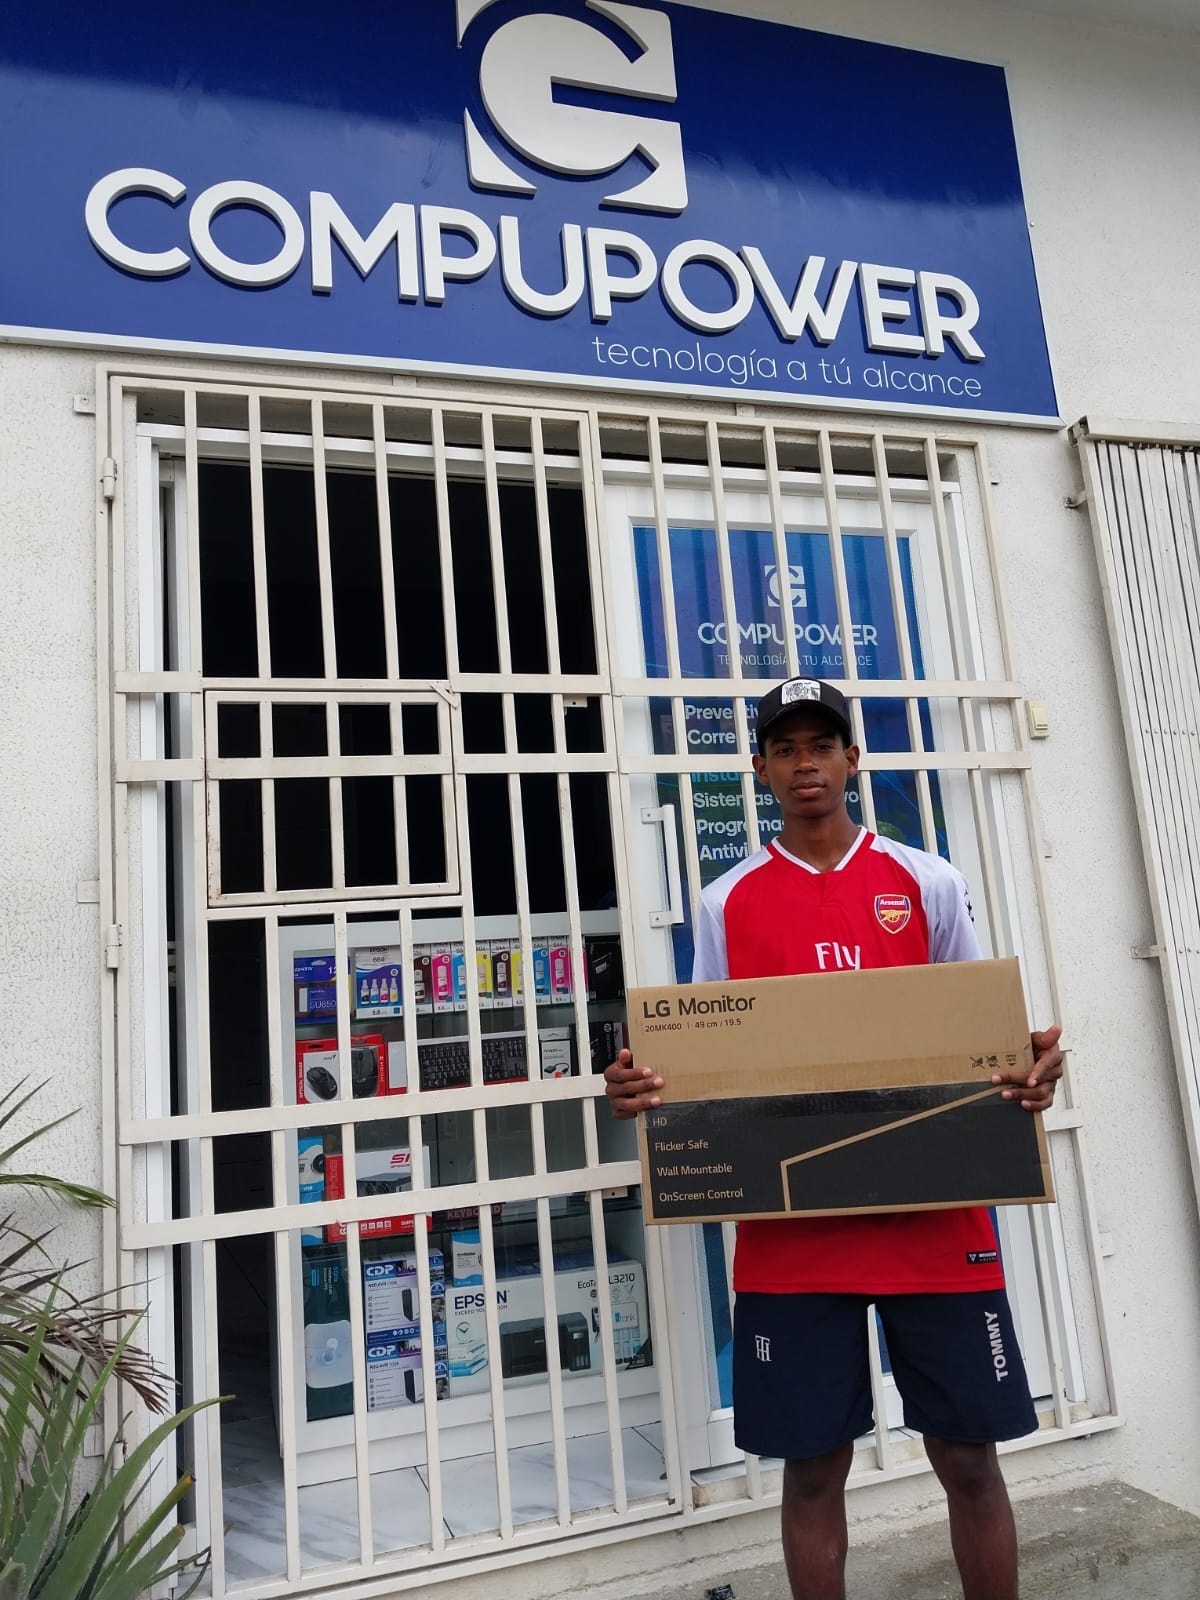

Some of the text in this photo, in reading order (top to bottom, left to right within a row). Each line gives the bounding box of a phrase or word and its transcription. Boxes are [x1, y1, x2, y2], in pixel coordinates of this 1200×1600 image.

[84, 166, 986, 363] COMPUPOWER
[591, 335, 983, 398] tecnología a tú alcance
[717, 651, 790, 667] TENOLOGÍA
[802, 654, 819, 667] TU
[820, 654, 874, 667] ALCCE
[685, 703, 760, 721] Preveti
[687, 728, 758, 746] Correti
[696, 818, 785, 837] Progrma
[699, 844, 749, 862] Antivi
[879, 898, 906, 907] Arsenal
[814, 941, 861, 971] Fly
[642, 994, 757, 1019] LG Monitor
[644, 1022, 682, 1033] 20MK400
[694, 1020, 705, 1029] 49
[706, 1021, 718, 1029] cm
[724, 1018, 742, 1027] 19.5
[652, 1116, 668, 1127] HD
[655, 1139, 709, 1152] Flicker Safe
[656, 1163, 733, 1177] Wall Mountable
[659, 1187, 744, 1203] OnScreen Control
[447, 1204, 501, 1219] KEYBOD
[366, 1264, 395, 1277] CDP
[608, 1272, 636, 1285] L3210
[577, 1279, 597, 1290] EcoT
[454, 1289, 508, 1310] EPSN
[367, 1345, 396, 1358] CDP
[983, 1310, 1009, 1383] TOMMY
